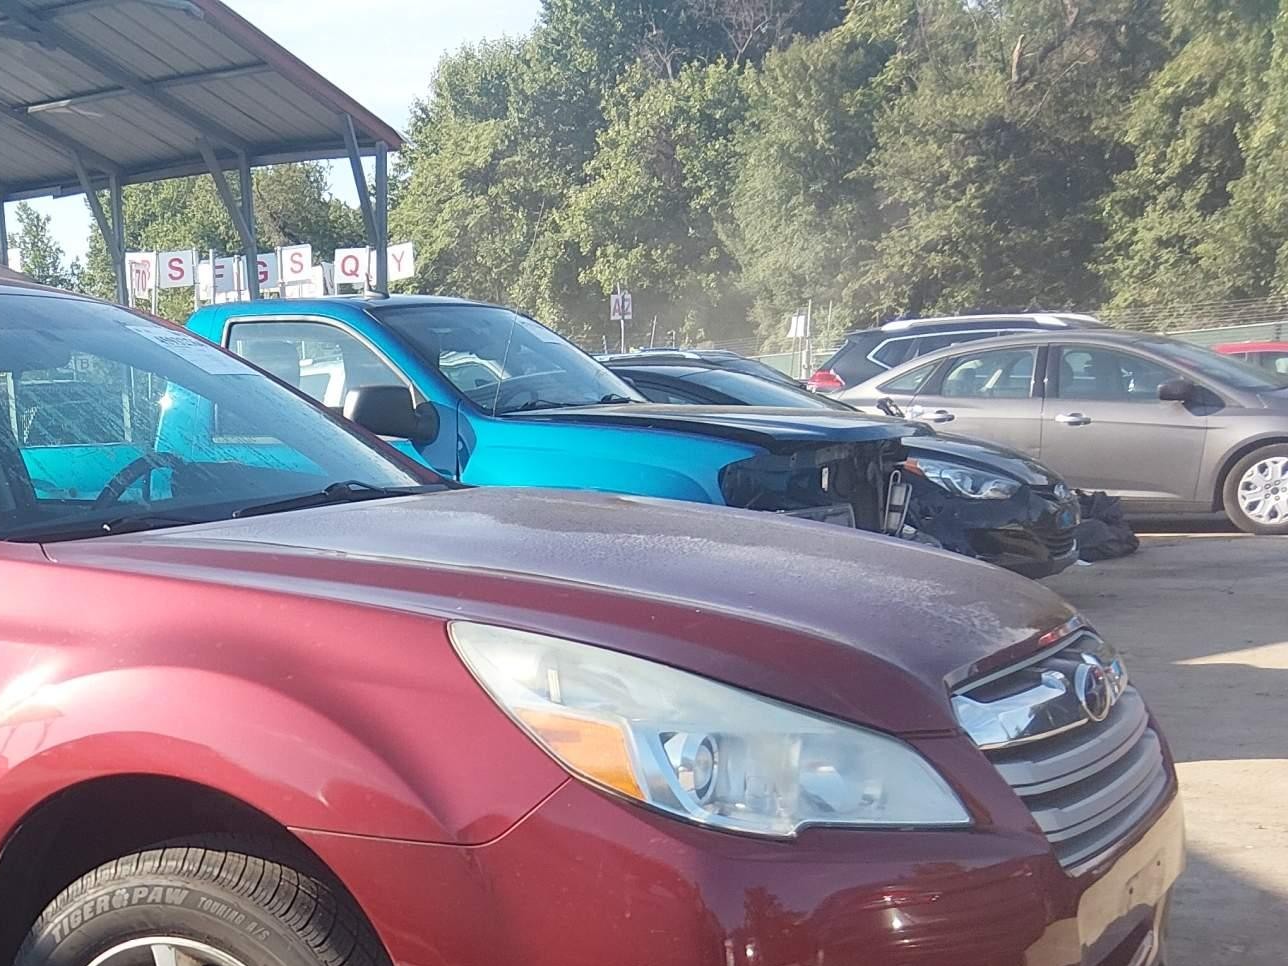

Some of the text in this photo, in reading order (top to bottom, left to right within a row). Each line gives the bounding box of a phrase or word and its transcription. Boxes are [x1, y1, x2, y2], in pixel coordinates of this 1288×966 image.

[167, 257, 185, 281] S
[290, 252, 304, 274] S
[341, 254, 360, 278] Q
[391, 250, 405, 273] Y
[52, 895, 112, 944] TIGER
[131, 886, 191, 906] PAW
